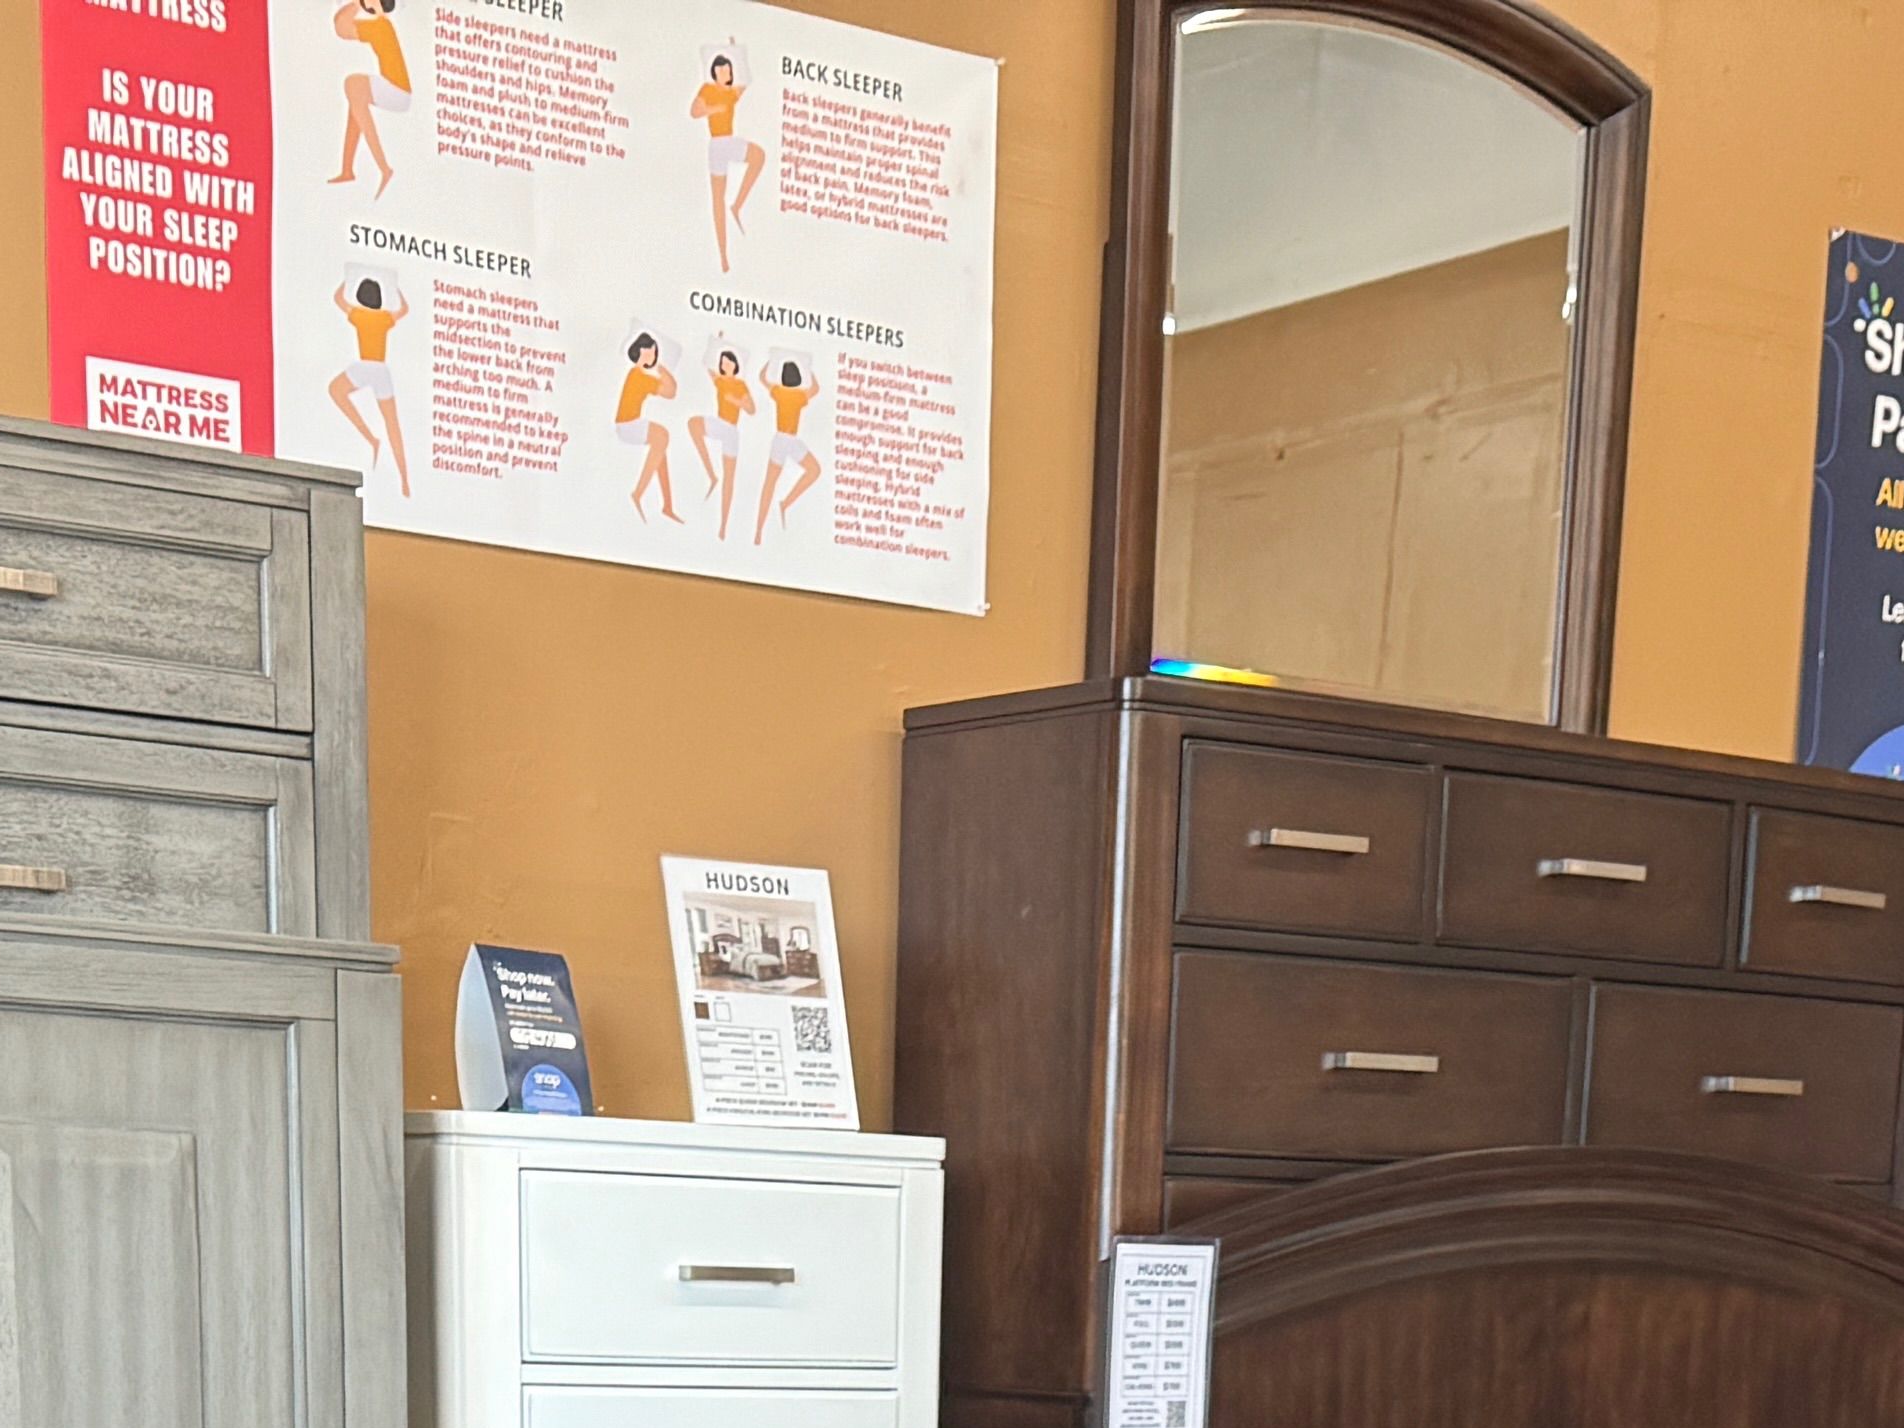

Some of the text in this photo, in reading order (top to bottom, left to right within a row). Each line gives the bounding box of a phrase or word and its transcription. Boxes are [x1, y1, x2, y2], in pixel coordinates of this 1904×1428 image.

[435, 8, 617, 61] Side sleepers need a mattress
[435, 26, 598, 72] that offers contouring and
[435, 44, 614, 93] pressure relief to cushion the
[435, 60, 496, 83] shoulders
[499, 74, 522, 88] and
[559, 85, 608, 110] Memory
[782, 56, 903, 102] BACK SLEEPER
[101, 68, 215, 123] IS YOUR
[436, 74, 468, 92] foam
[472, 84, 494, 98] and
[499, 90, 531, 106] plush
[535, 98, 547, 110] to
[436, 92, 605, 139] mattresses can be excellent
[87, 107, 230, 169] MATTRESS
[438, 141, 535, 172] pressure points.
[480, 132, 515, 152] shape
[520, 143, 541, 157] and
[545, 147, 586, 166] relieve
[490, 120, 502, 132] as
[506, 123, 533, 141] they
[536, 129, 587, 150] conform
[590, 141, 602, 153] to
[606, 144, 625, 159] the
[61, 145, 255, 216] ALIGNED WITH
[79, 190, 239, 253] YOUR SLEEP
[88, 235, 232, 292] POSITION?
[350, 224, 531, 279] STOMACH SLEEPER
[433, 279, 538, 312] Stomach sleepers
[433, 298, 559, 330] need a mattress that
[433, 314, 511, 336] supports the
[690, 291, 904, 348] COMBINATION SLEEPERS
[433, 329, 566, 364] midsection to prevent
[433, 345, 554, 377] the lower back from
[99, 372, 230, 413] MATTRESS
[433, 362, 480, 383] arching
[483, 369, 503, 383] too
[545, 380, 553, 392] A
[433, 377, 528, 404] medium to firm
[99, 398, 231, 444] NEAR ME
[433, 394, 559, 427] mattress is generally
[1875, 477, 1904, 509] All
[706, 872, 789, 896] HUDSON
[1137, 1264, 1188, 1276] HUDSON
